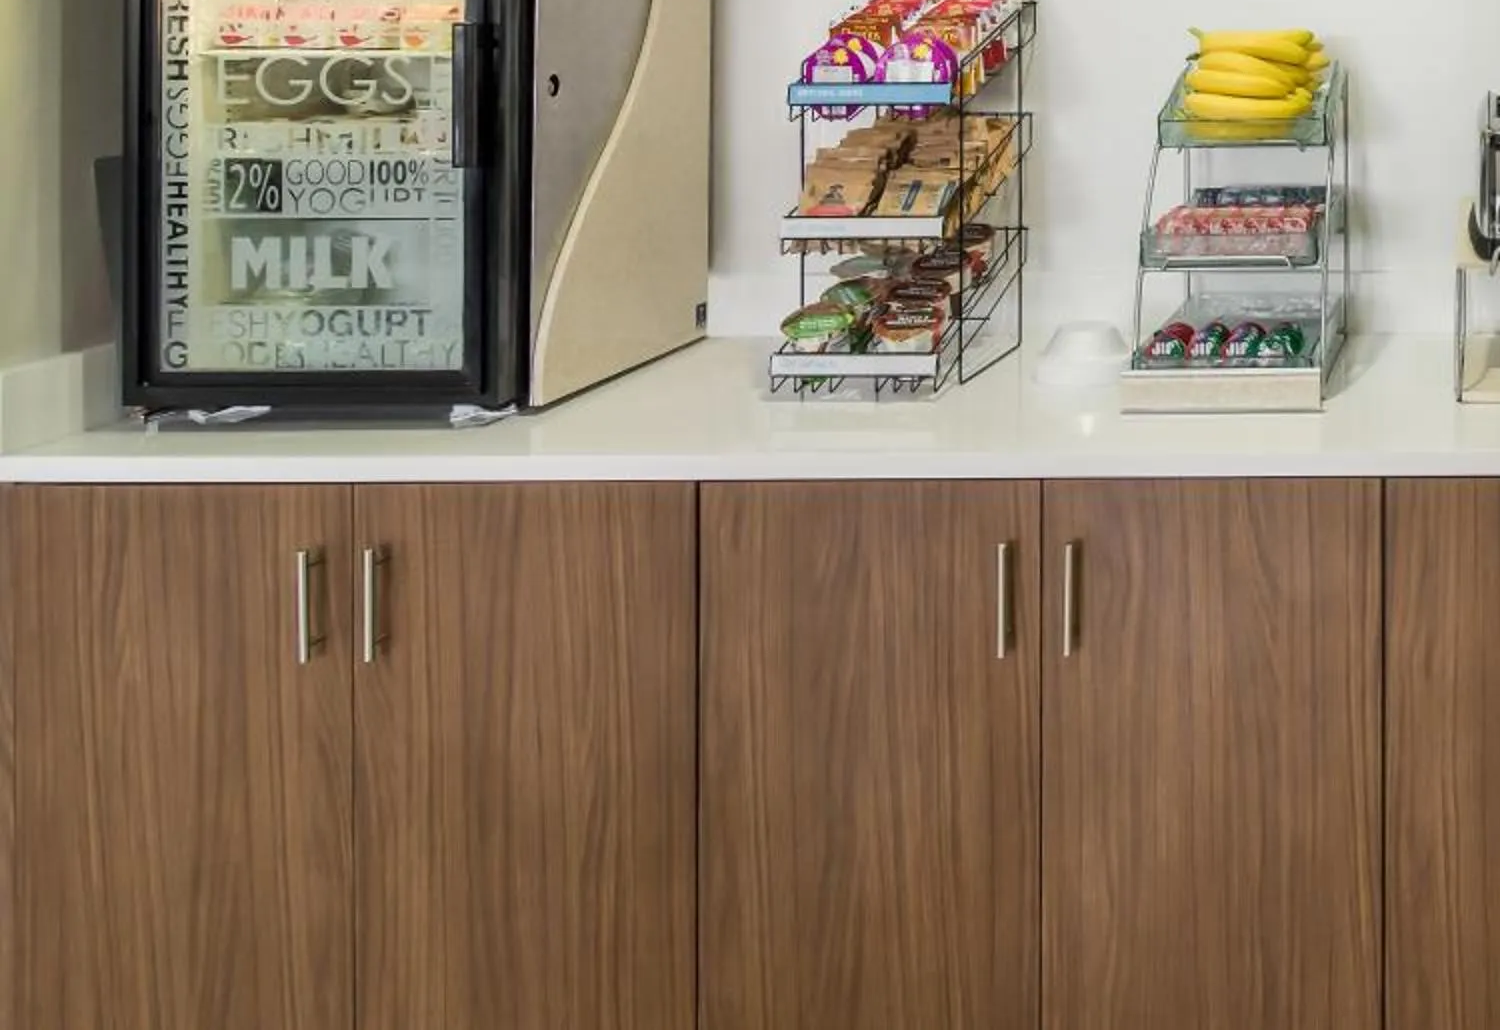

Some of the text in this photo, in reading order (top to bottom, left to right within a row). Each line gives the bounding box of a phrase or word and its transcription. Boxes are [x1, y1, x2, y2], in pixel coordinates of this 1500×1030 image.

[216, 54, 412, 107] EGGS
[229, 162, 279, 210] 2%
[285, 159, 365, 186] GOOD
[370, 159, 429, 186] 100%
[166, 181, 190, 309] HEALTHY
[230, 235, 397, 290] MILK
